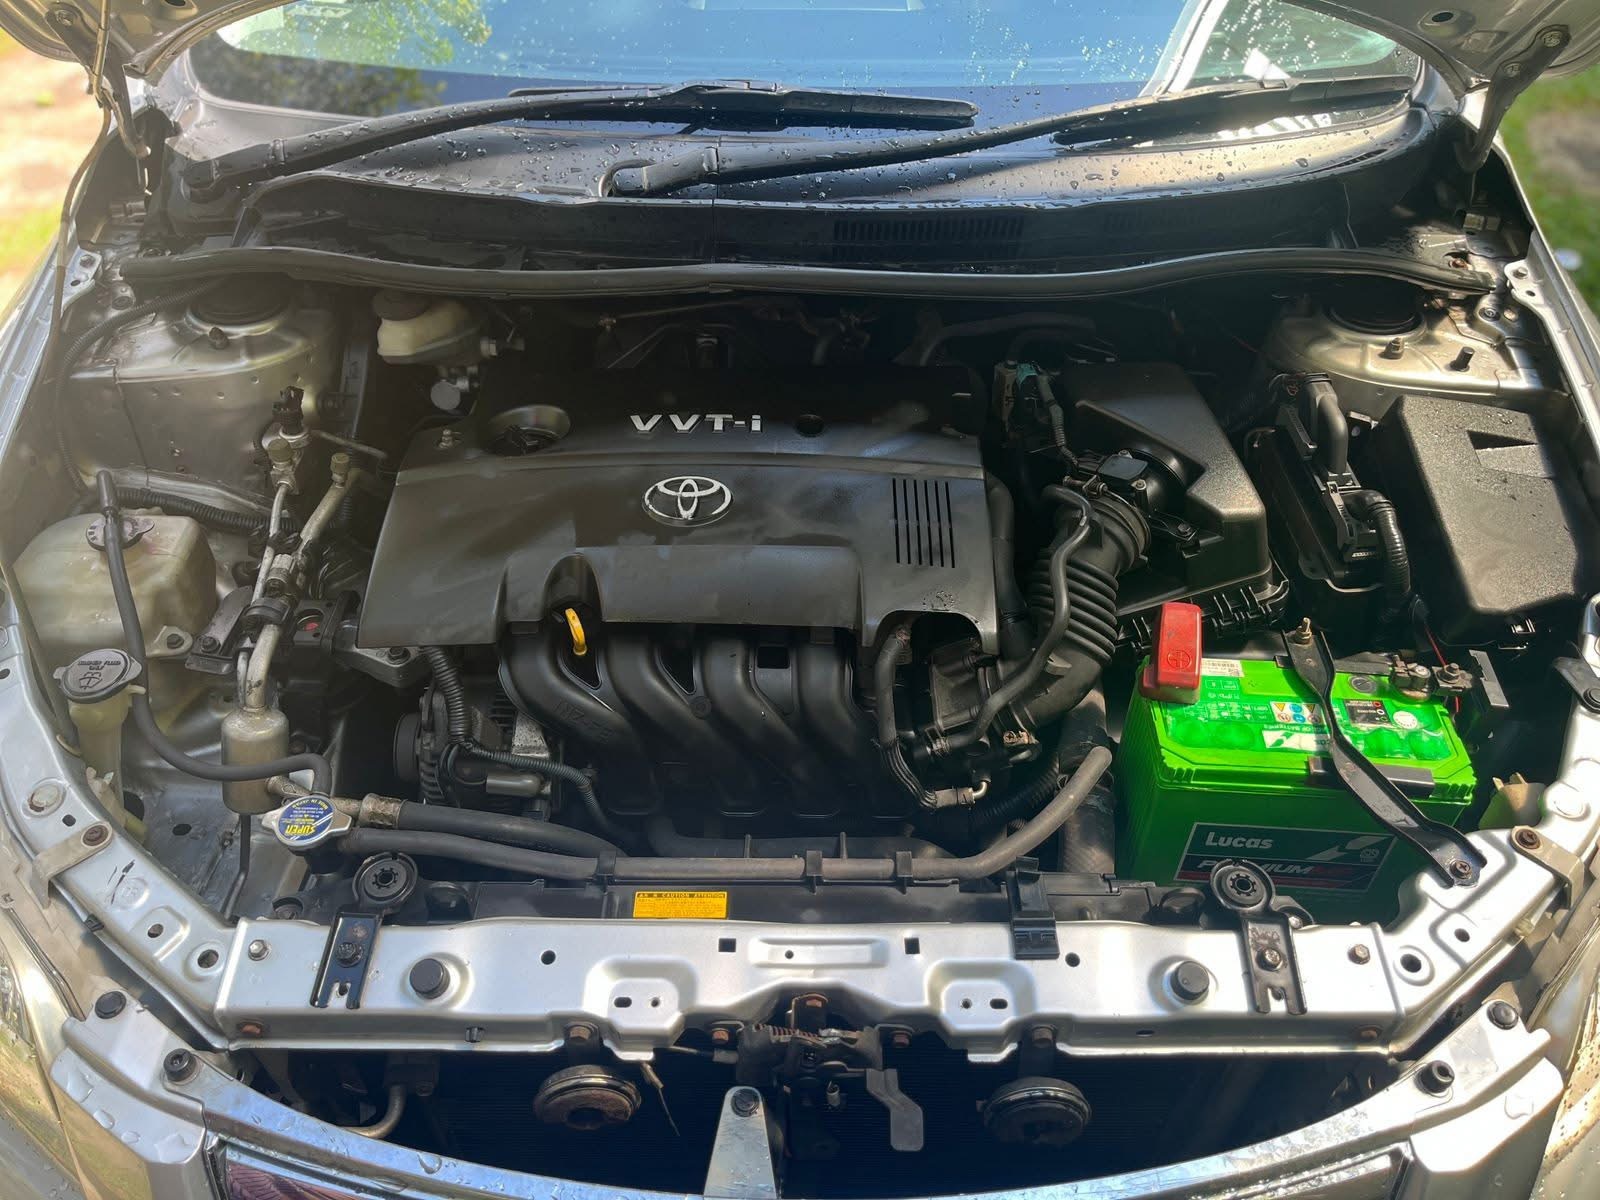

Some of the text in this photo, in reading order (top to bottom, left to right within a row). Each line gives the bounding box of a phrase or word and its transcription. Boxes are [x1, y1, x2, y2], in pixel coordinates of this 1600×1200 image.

[630, 414, 762, 433] VVT-i
[285, 824, 315, 835] SUPER
[1205, 831, 1273, 849] Lucas
